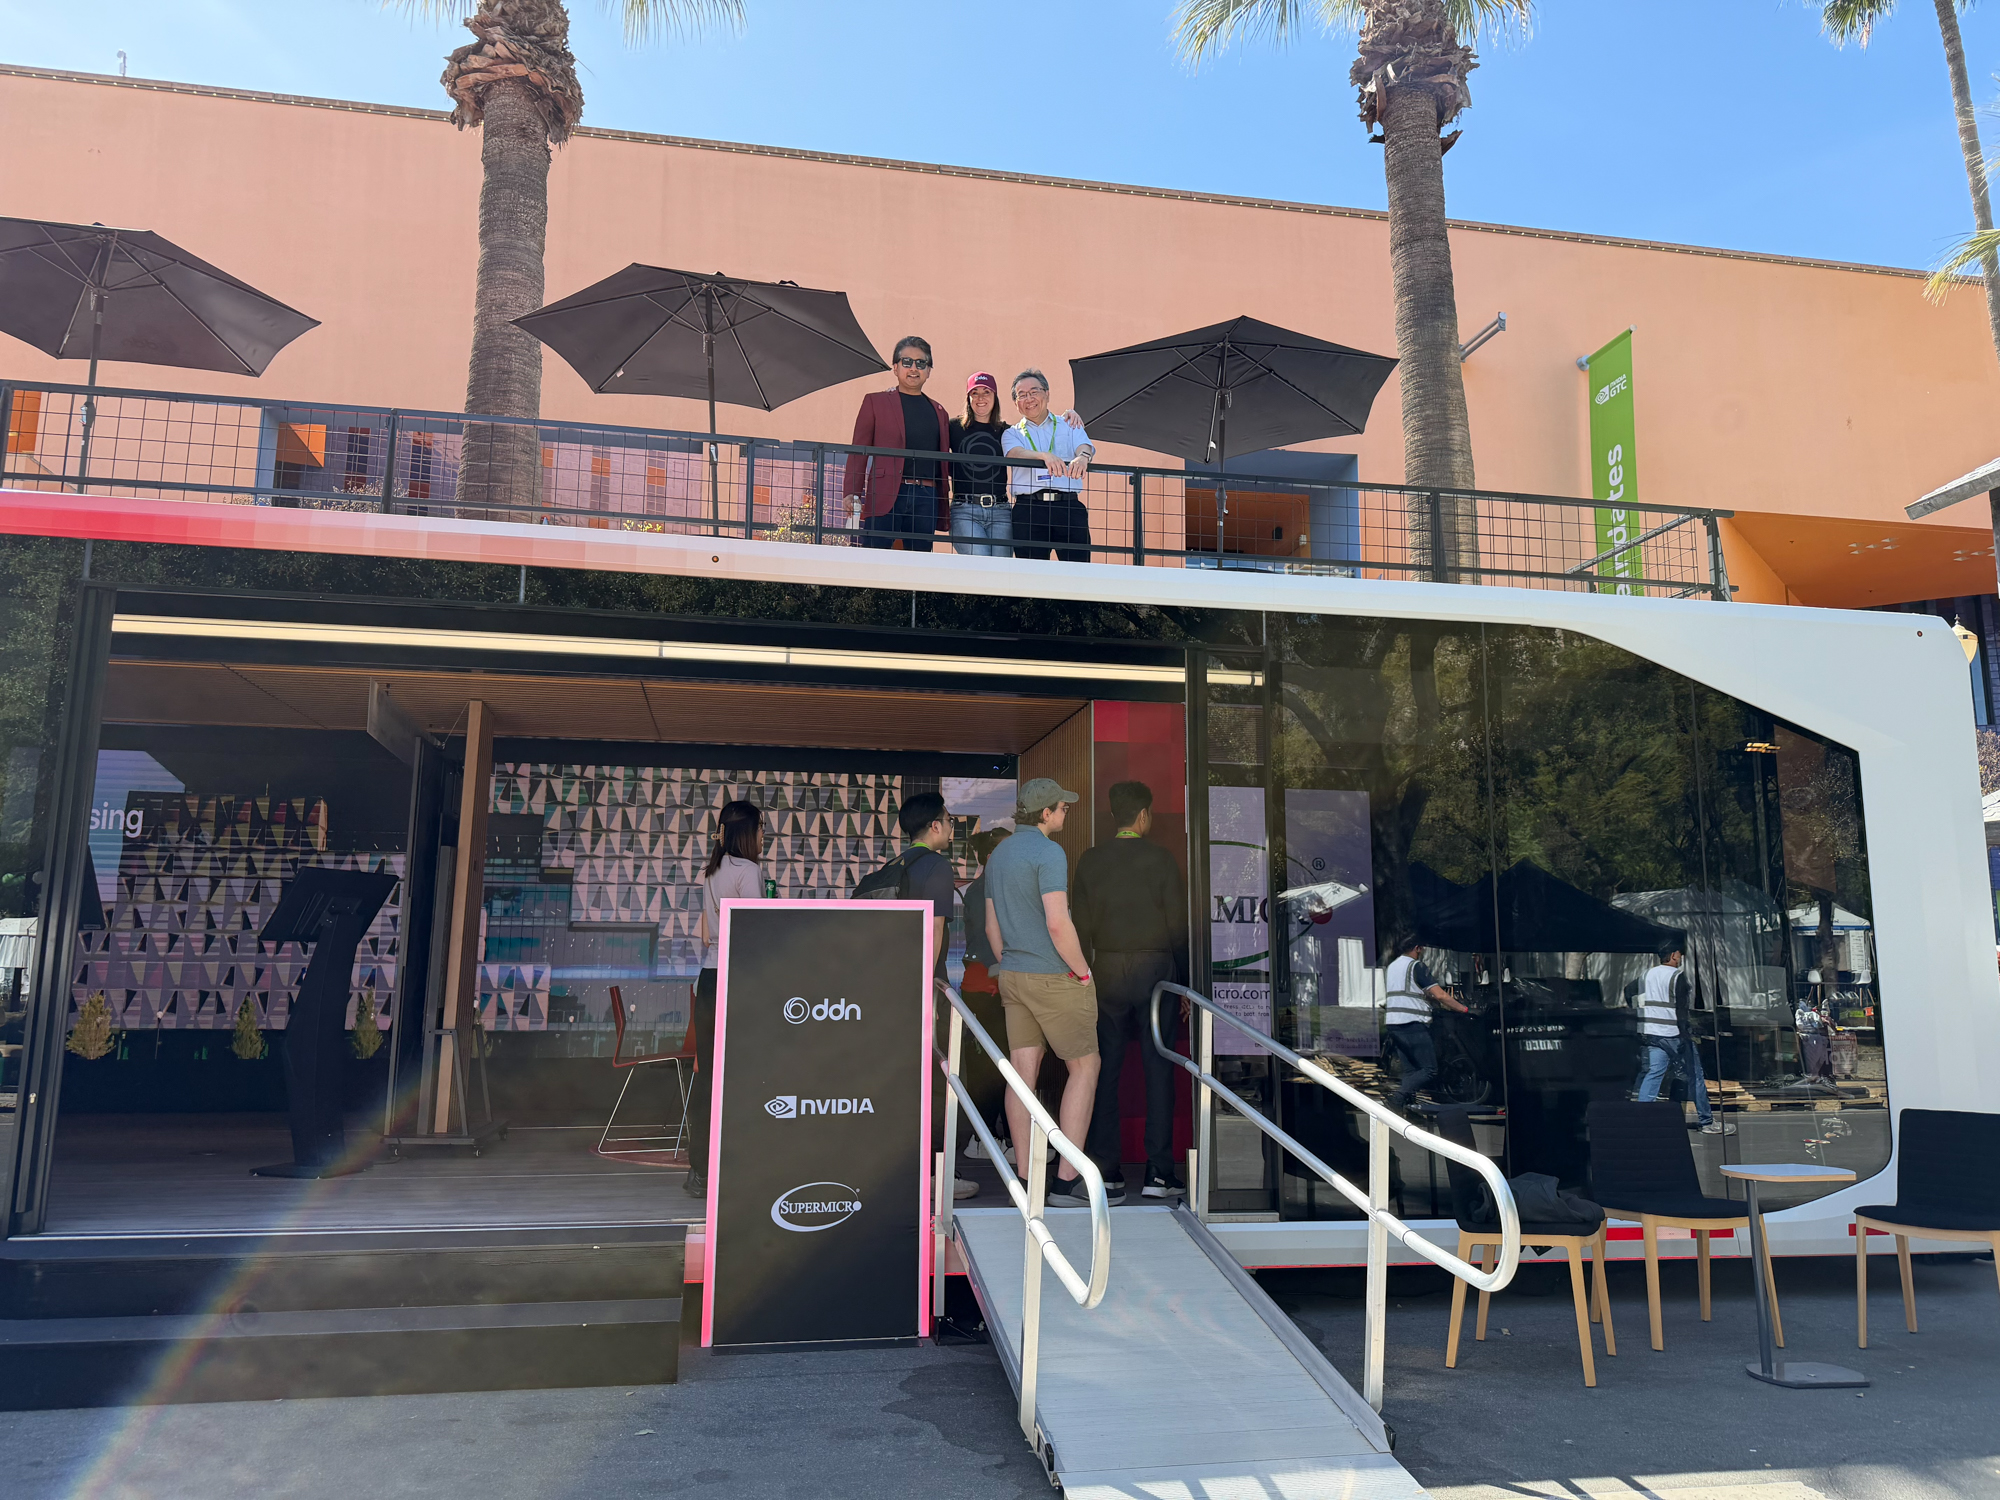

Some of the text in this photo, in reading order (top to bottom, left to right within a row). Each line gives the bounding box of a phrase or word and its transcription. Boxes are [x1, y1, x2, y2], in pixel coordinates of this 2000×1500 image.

[1610, 379, 1627, 398] GTC
[89, 801, 144, 838] sing
[811, 998, 861, 1021] ddn
